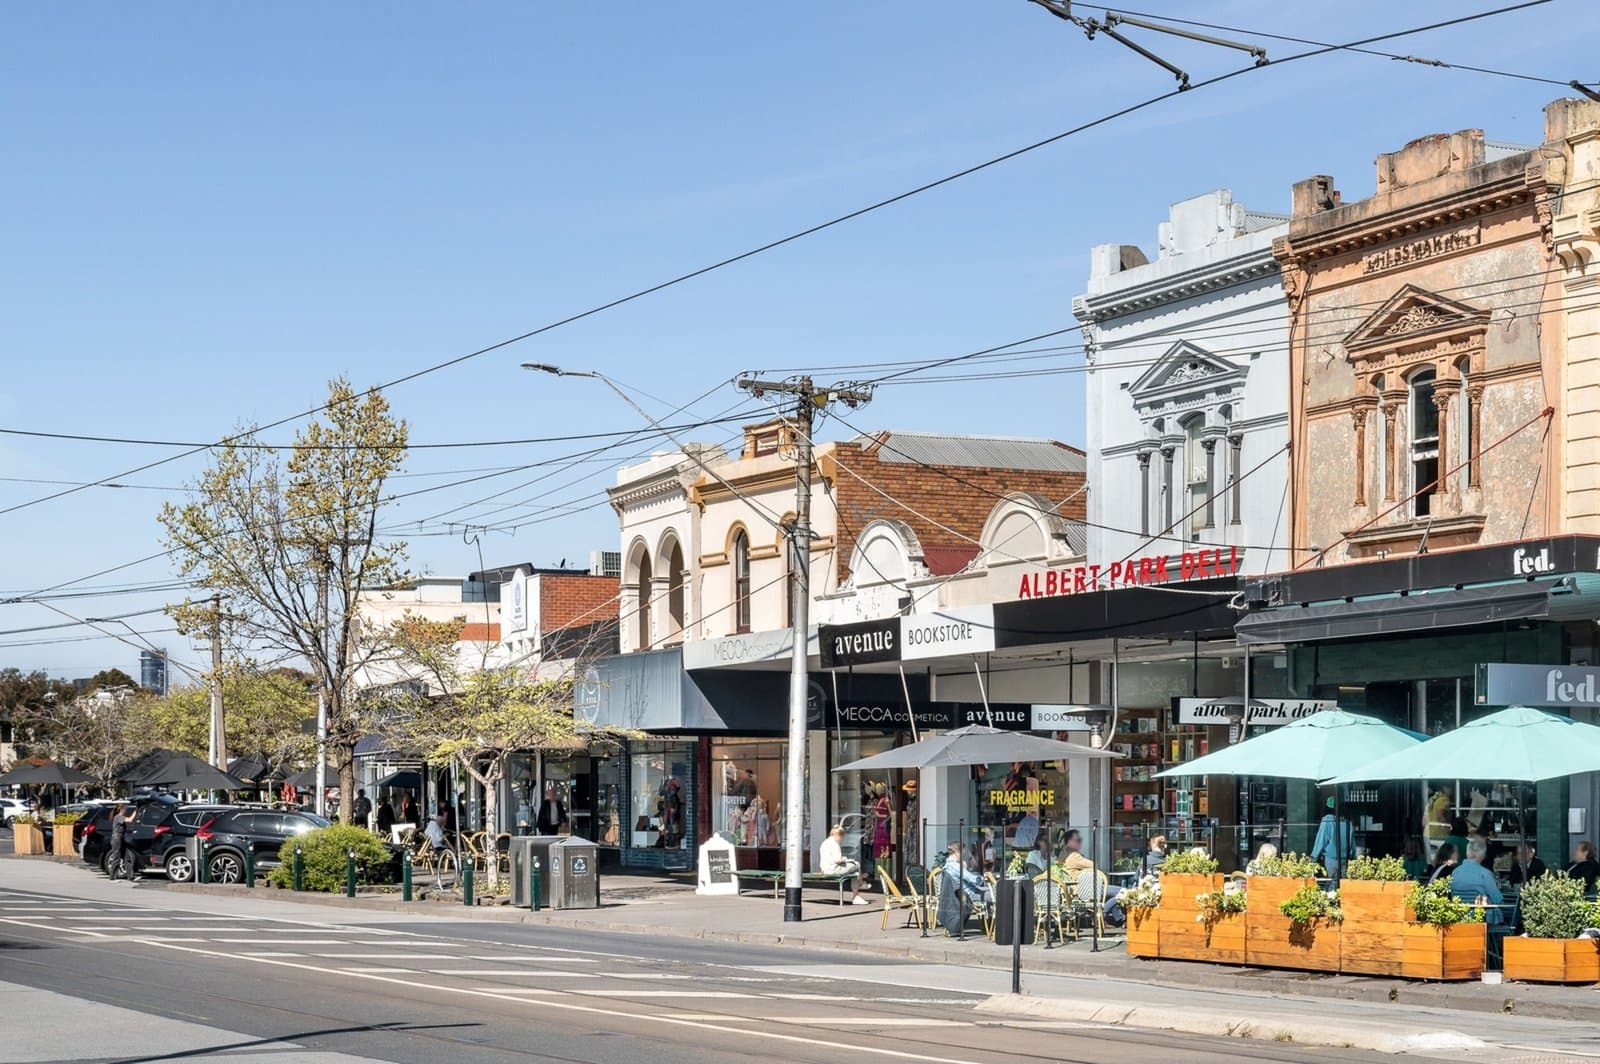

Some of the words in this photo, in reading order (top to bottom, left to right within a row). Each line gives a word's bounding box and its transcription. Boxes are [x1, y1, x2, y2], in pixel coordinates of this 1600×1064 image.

[1019, 564, 1101, 598] ALBERT
[1110, 555, 1169, 587] PARK
[1181, 545, 1237, 579] DELI
[1513, 548, 1555, 574] fed.
[835, 628, 893, 655] avenue
[908, 623, 973, 646] BOOKSTORE
[1546, 669, 1600, 703] fed.
[838, 707, 893, 722] MECCA
[966, 710, 1025, 724] avenue
[1038, 713, 1084, 722] BOOKSTO
[1248, 702, 1287, 721] park
[990, 790, 1054, 805] FRAGRANCE
